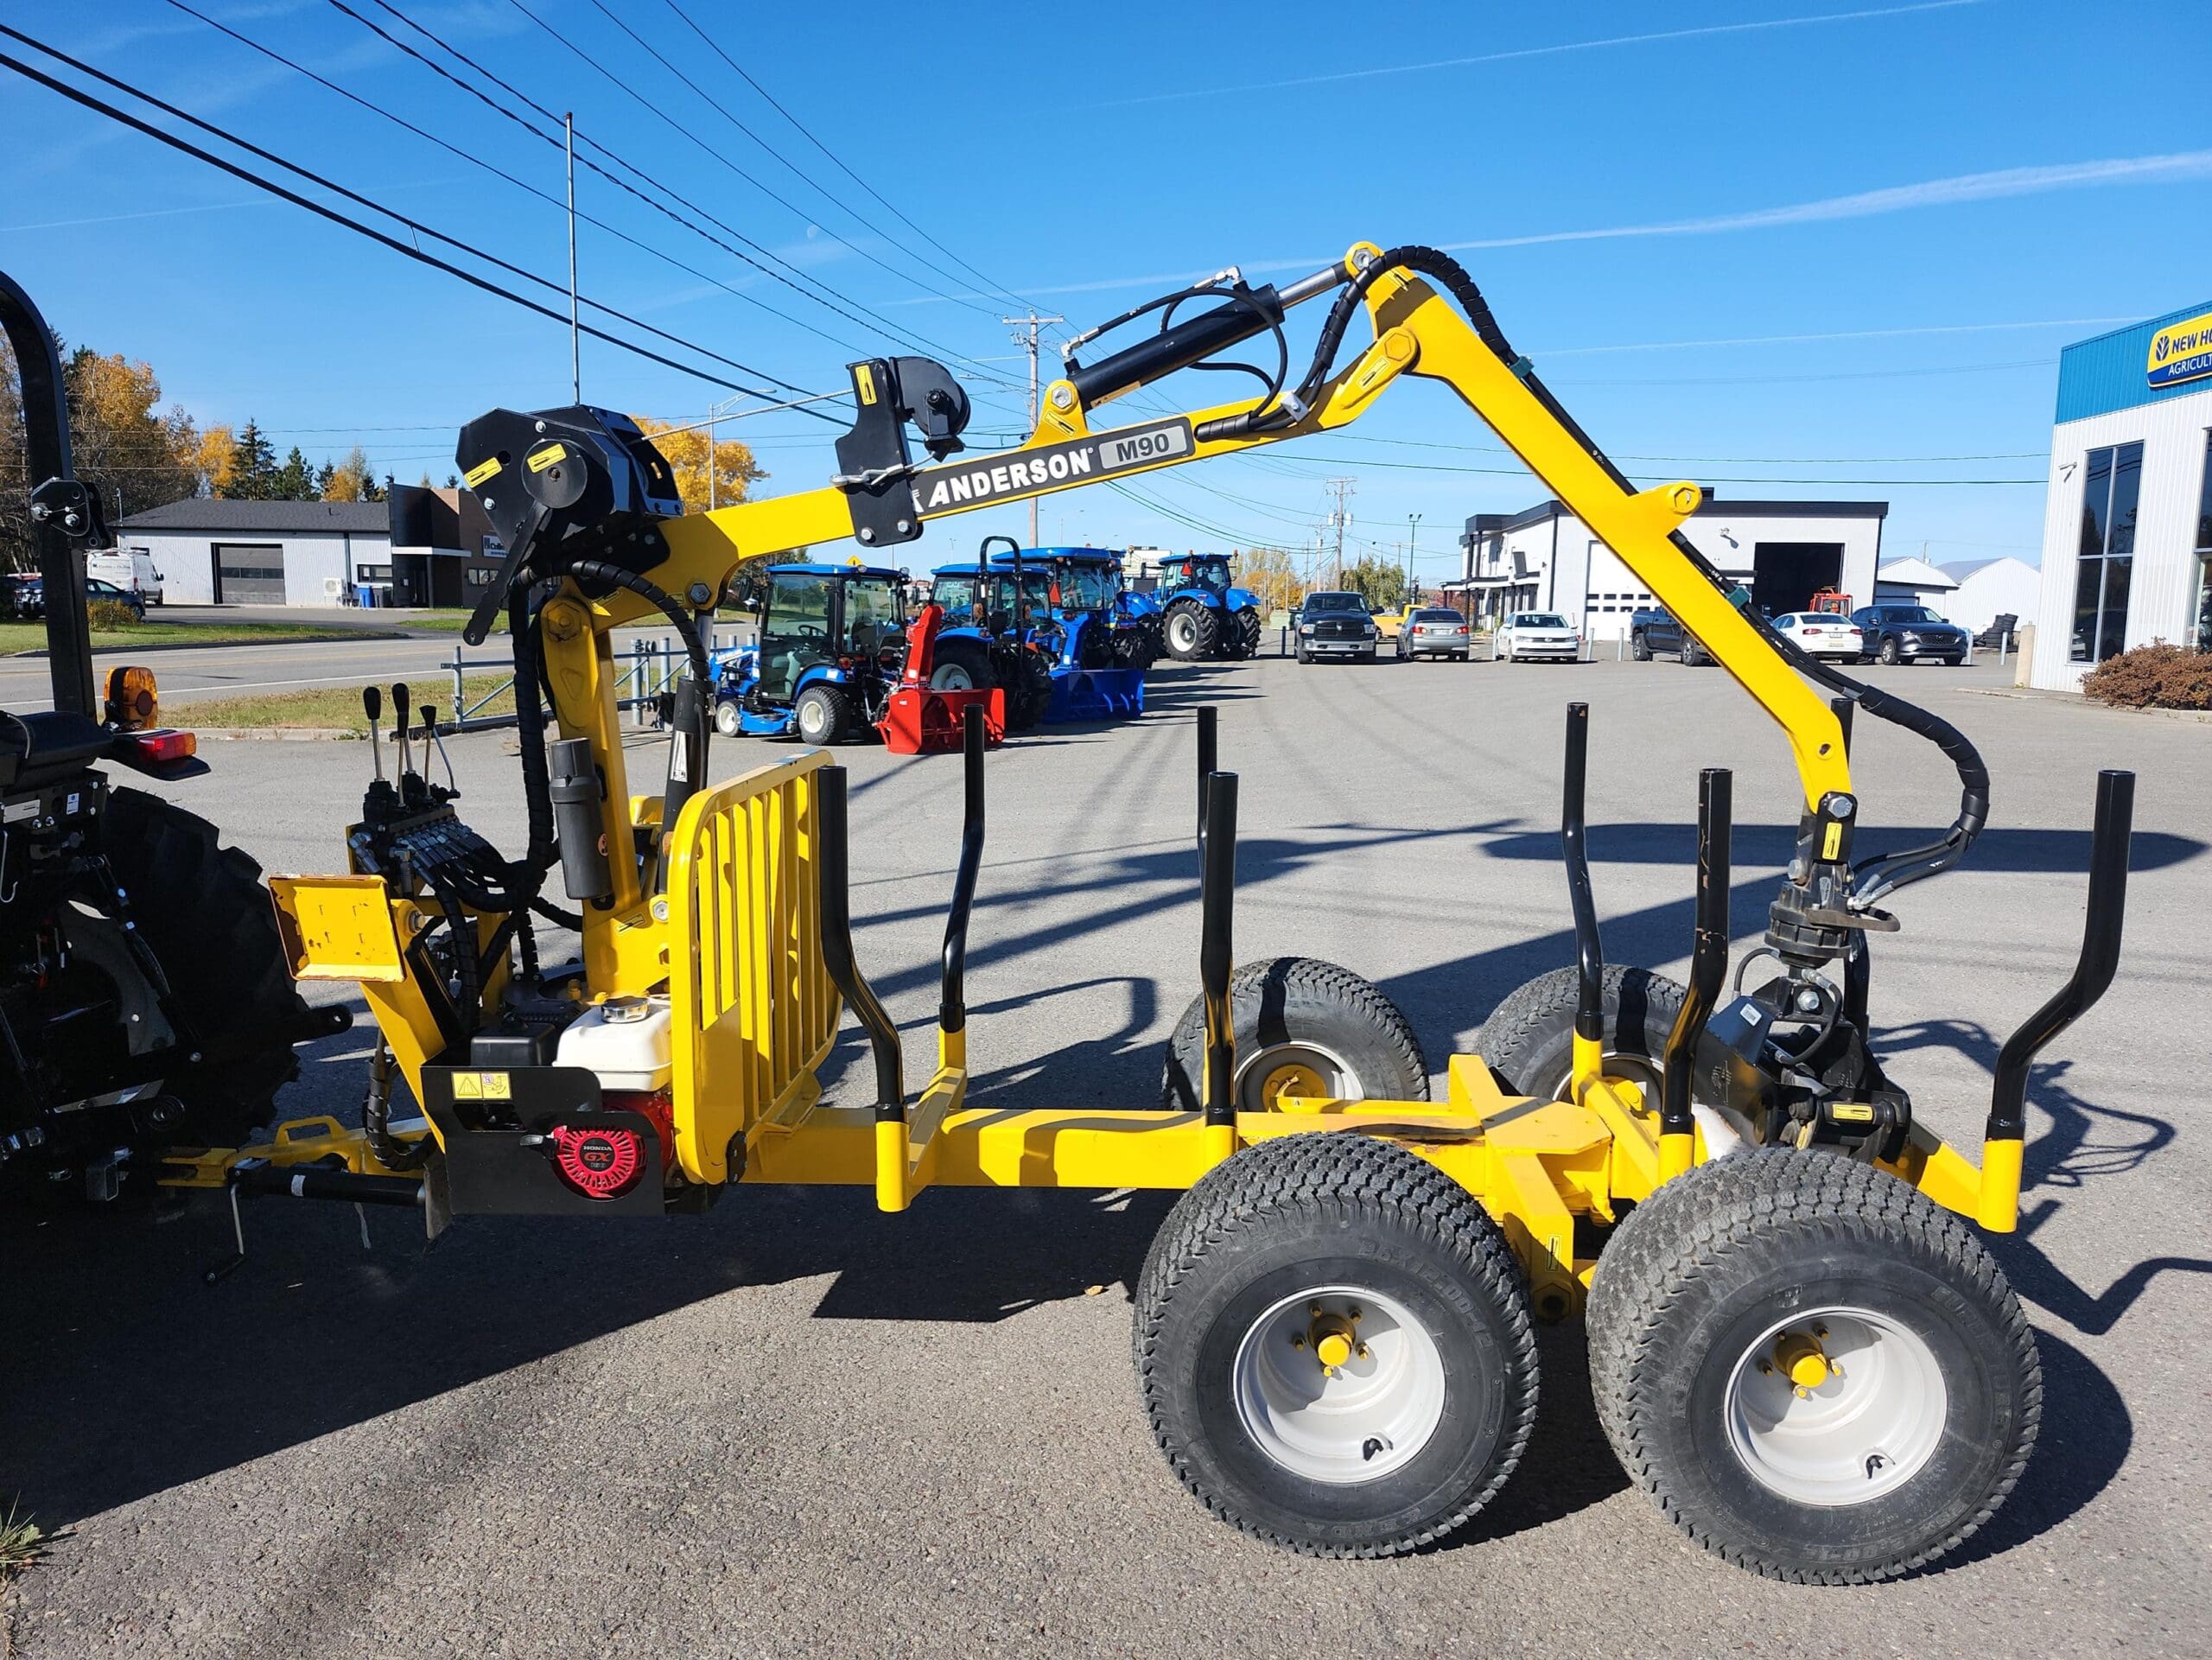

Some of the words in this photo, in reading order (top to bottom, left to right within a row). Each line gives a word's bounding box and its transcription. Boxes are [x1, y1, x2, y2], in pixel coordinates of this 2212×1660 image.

[2172, 333, 2198, 353] NEW
[928, 448, 1091, 508] ANDERSON
[1116, 433, 1170, 462] M90
[584, 1152, 610, 1161] GX
